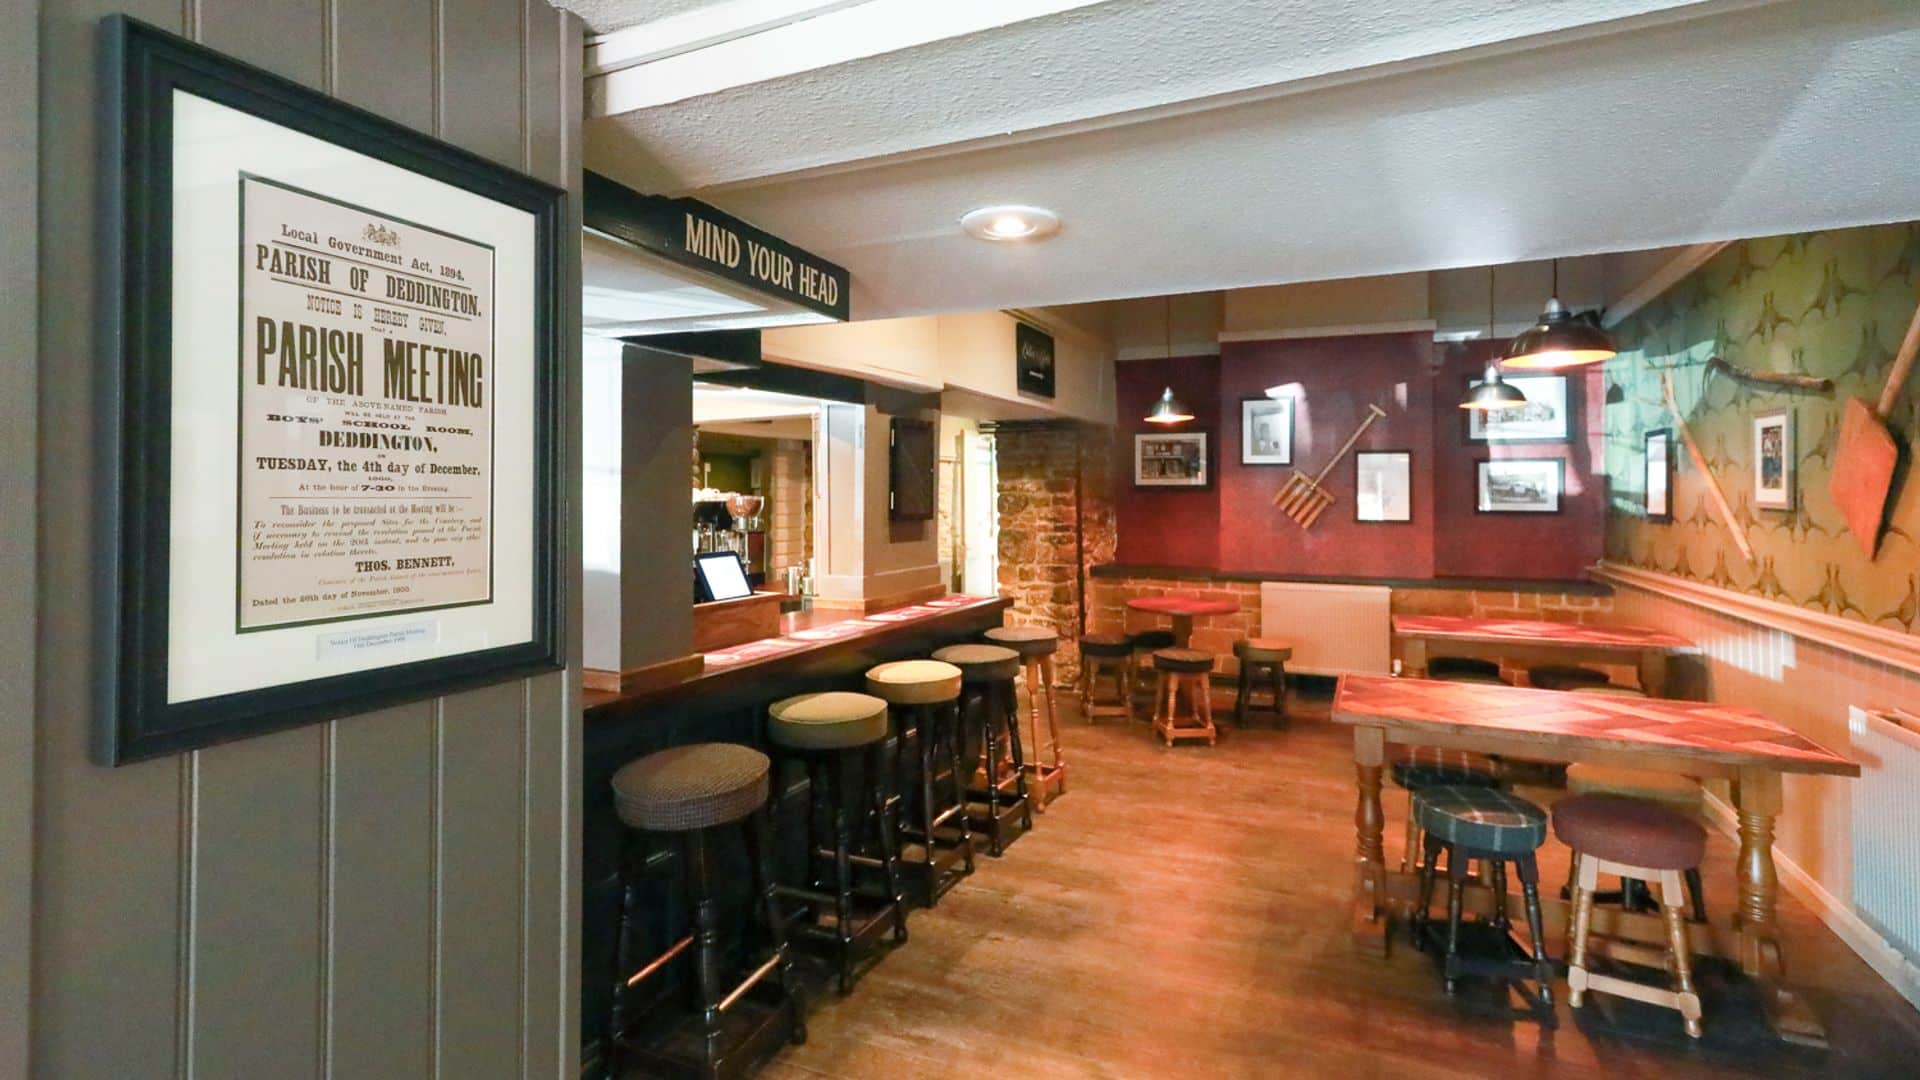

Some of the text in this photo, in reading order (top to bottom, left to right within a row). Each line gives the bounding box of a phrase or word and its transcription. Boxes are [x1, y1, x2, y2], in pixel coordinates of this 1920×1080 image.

[282, 224, 318, 244] Local
[328, 236, 402, 266] Government
[686, 212, 838, 306] MIND YOUR HEAD
[256, 244, 482, 317] PARISH OF DEDDINGTON.
[307, 294, 342, 316] NOTICE
[354, 303, 363, 320] IS
[374, 308, 409, 328] HEREBY
[256, 316, 482, 408] PARISH MEETING
[327, 397, 345, 406] THE
[418, 407, 447, 415] PARISH
[342, 420, 411, 431] SCHOOL
[425, 426, 474, 436] ROOM,
[319, 430, 438, 453] DEDDINGTON,
[256, 457, 332, 472] TUESDAY,
[337, 459, 357, 472] the
[362, 460, 382, 473] 4th
[387, 461, 409, 476] day
[415, 463, 428, 474] of
[281, 504, 294, 515] The
[298, 504, 329, 515] Business
[343, 504, 351, 514] be
[355, 560, 391, 573] THOS.
[252, 598, 278, 607] Dated
